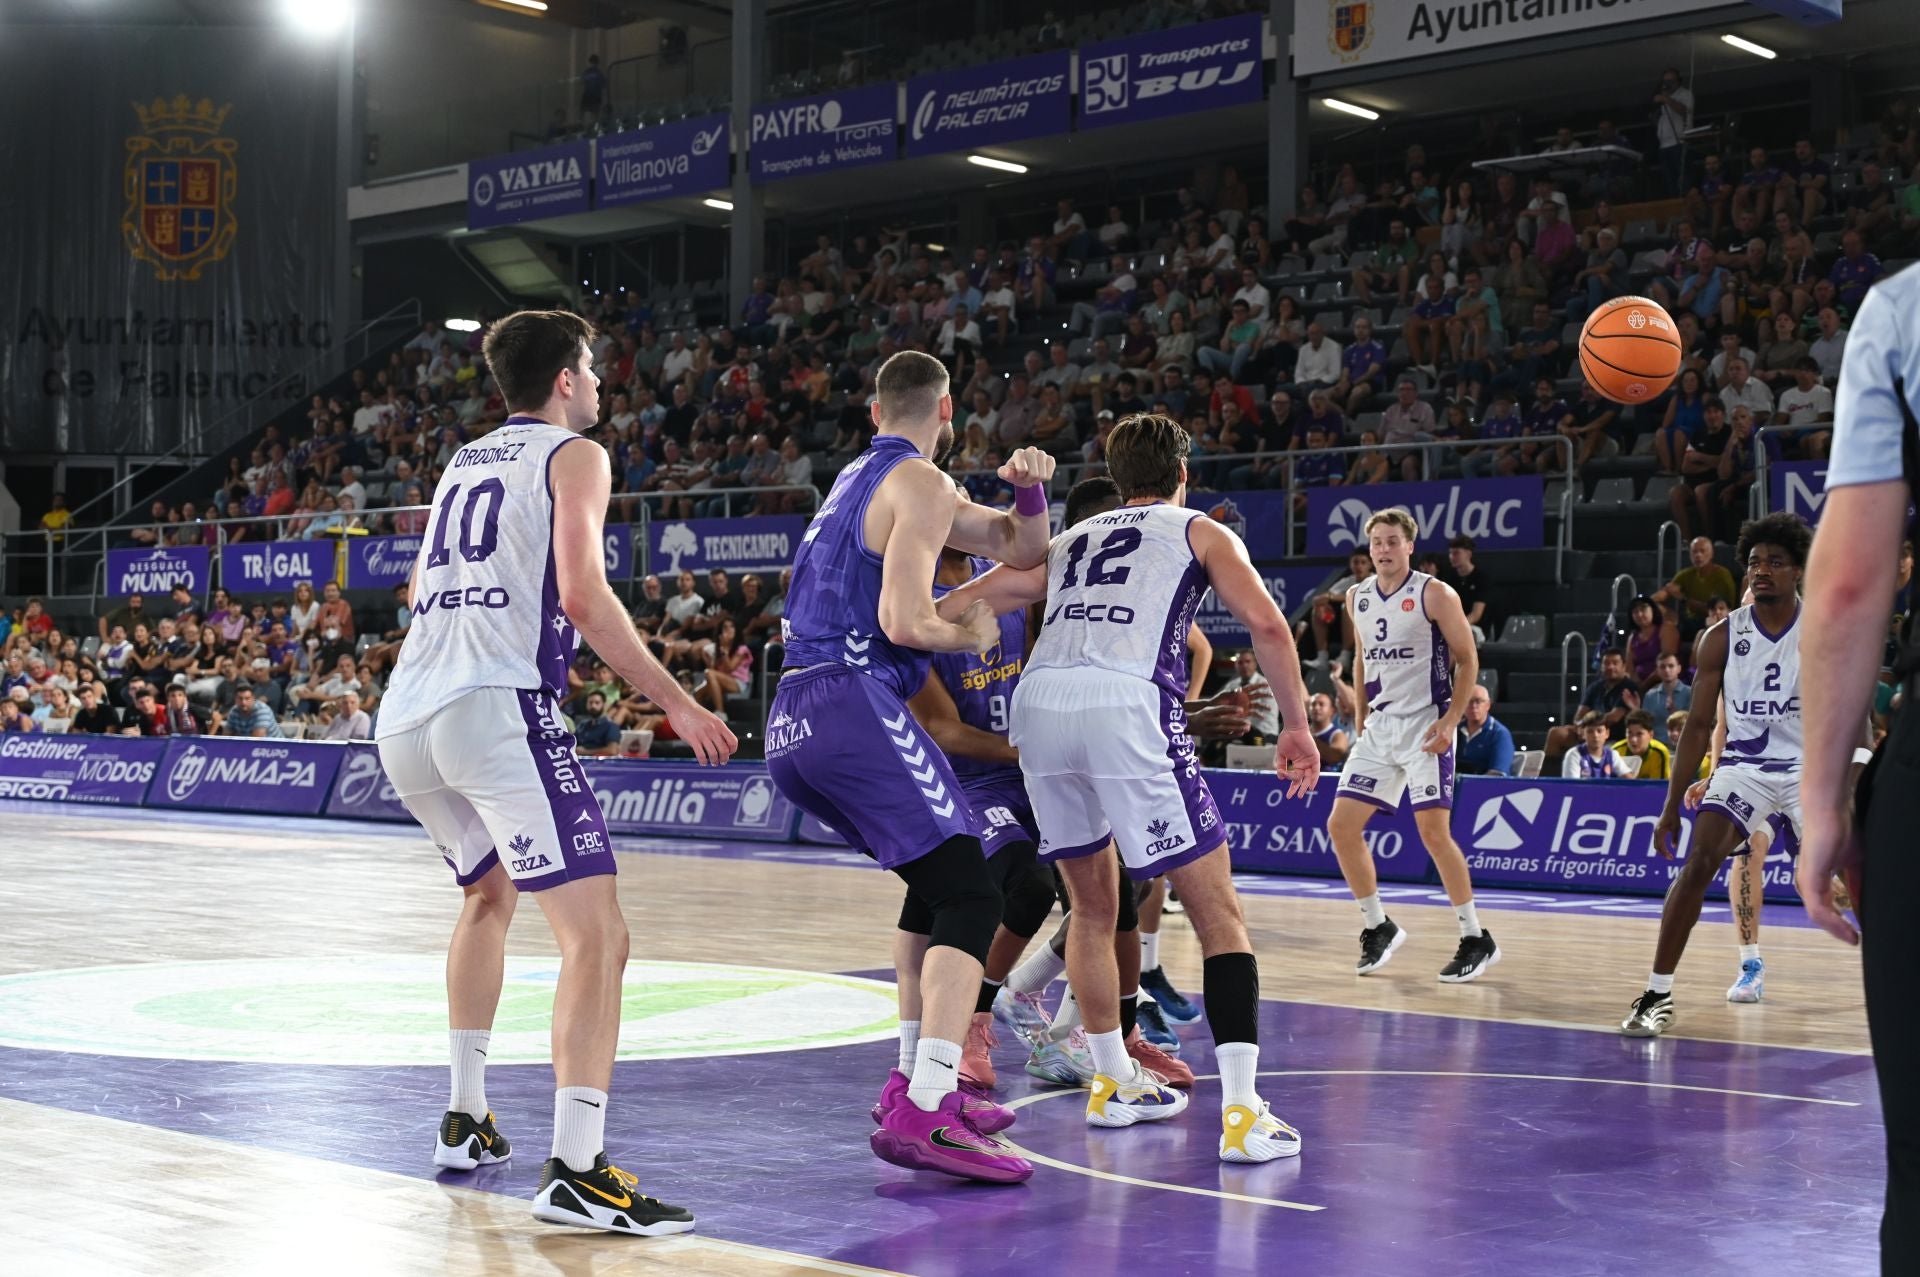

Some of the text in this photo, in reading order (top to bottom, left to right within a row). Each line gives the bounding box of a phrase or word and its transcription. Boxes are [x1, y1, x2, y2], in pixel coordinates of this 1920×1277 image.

[1139, 38, 1251, 69] Transportes
[942, 74, 1065, 111] NEUMÁTICOS
[1133, 60, 1256, 99] BUJ
[935, 101, 1029, 132] PALENCIA
[833, 121, 893, 144] Trans
[602, 140, 653, 159] Interiorismo
[761, 155, 813, 174] Transporte
[817, 151, 831, 164] de
[498, 156, 582, 193] VAYMA
[603, 154, 689, 186] Villanova
[18, 306, 333, 352] Ayuntamiento
[43, 359, 310, 403] de Palencia
[427, 477, 505, 570] 10
[704, 533, 789, 561] TECNICAMPO
[1059, 526, 1143, 592] 12
[129, 560, 187, 573] DESGUACE
[121, 571, 194, 593] MUNDO
[1375, 618, 1388, 641] 3
[960, 667, 983, 678] super
[962, 658, 1022, 690] agropal
[1764, 662, 1781, 691] 2
[2, 736, 85, 760] Gestinver.
[251, 747, 289, 759] GRUPO
[77, 760, 155, 783] MODOS
[204, 757, 316, 787] INMAPA
[1726, 800, 1750, 820] HYUNDAI
[573, 831, 603, 852] CBC
[1145, 834, 1186, 857] CRZA
[1223, 822, 1263, 850] EY
[511, 854, 552, 873] CRZA
[1465, 851, 1540, 872] cámaras
[1544, 855, 1647, 880] frigoríficas
